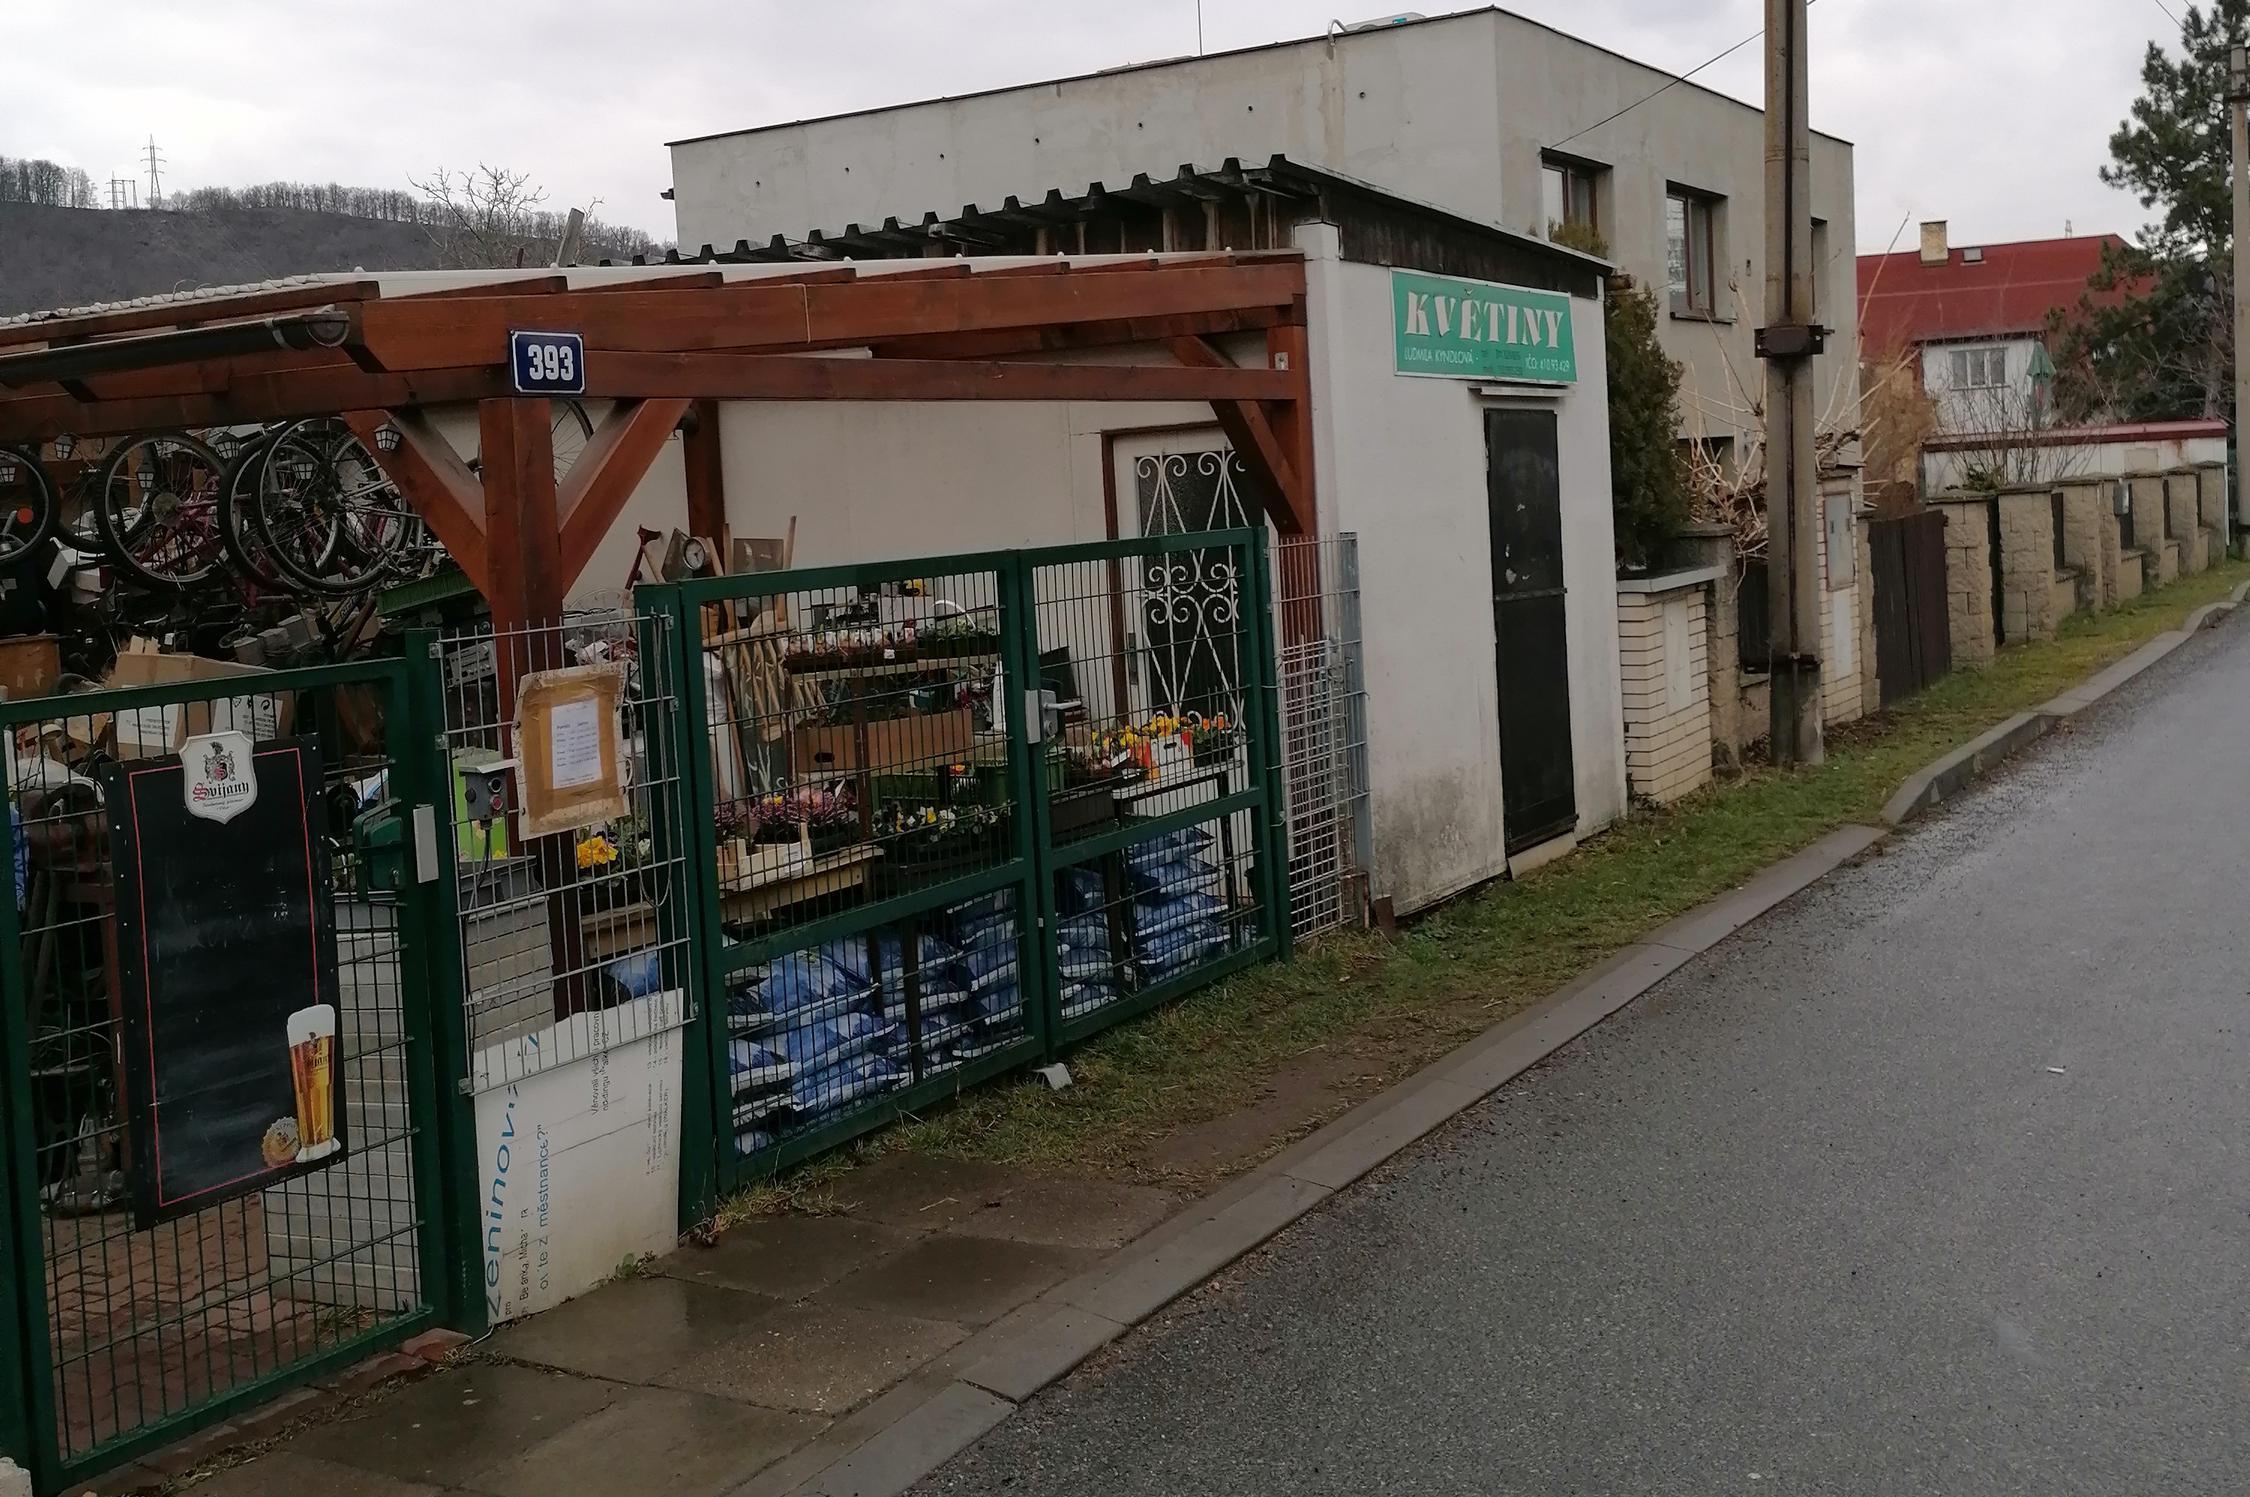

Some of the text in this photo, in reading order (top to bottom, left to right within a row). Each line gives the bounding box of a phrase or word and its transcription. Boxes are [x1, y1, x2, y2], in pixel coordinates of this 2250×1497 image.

[1404, 288, 1563, 348] KVĚTINY
[527, 344, 574, 381] 393
[1404, 346, 1432, 362] LUDMILA
[192, 781, 249, 803] Svijany
